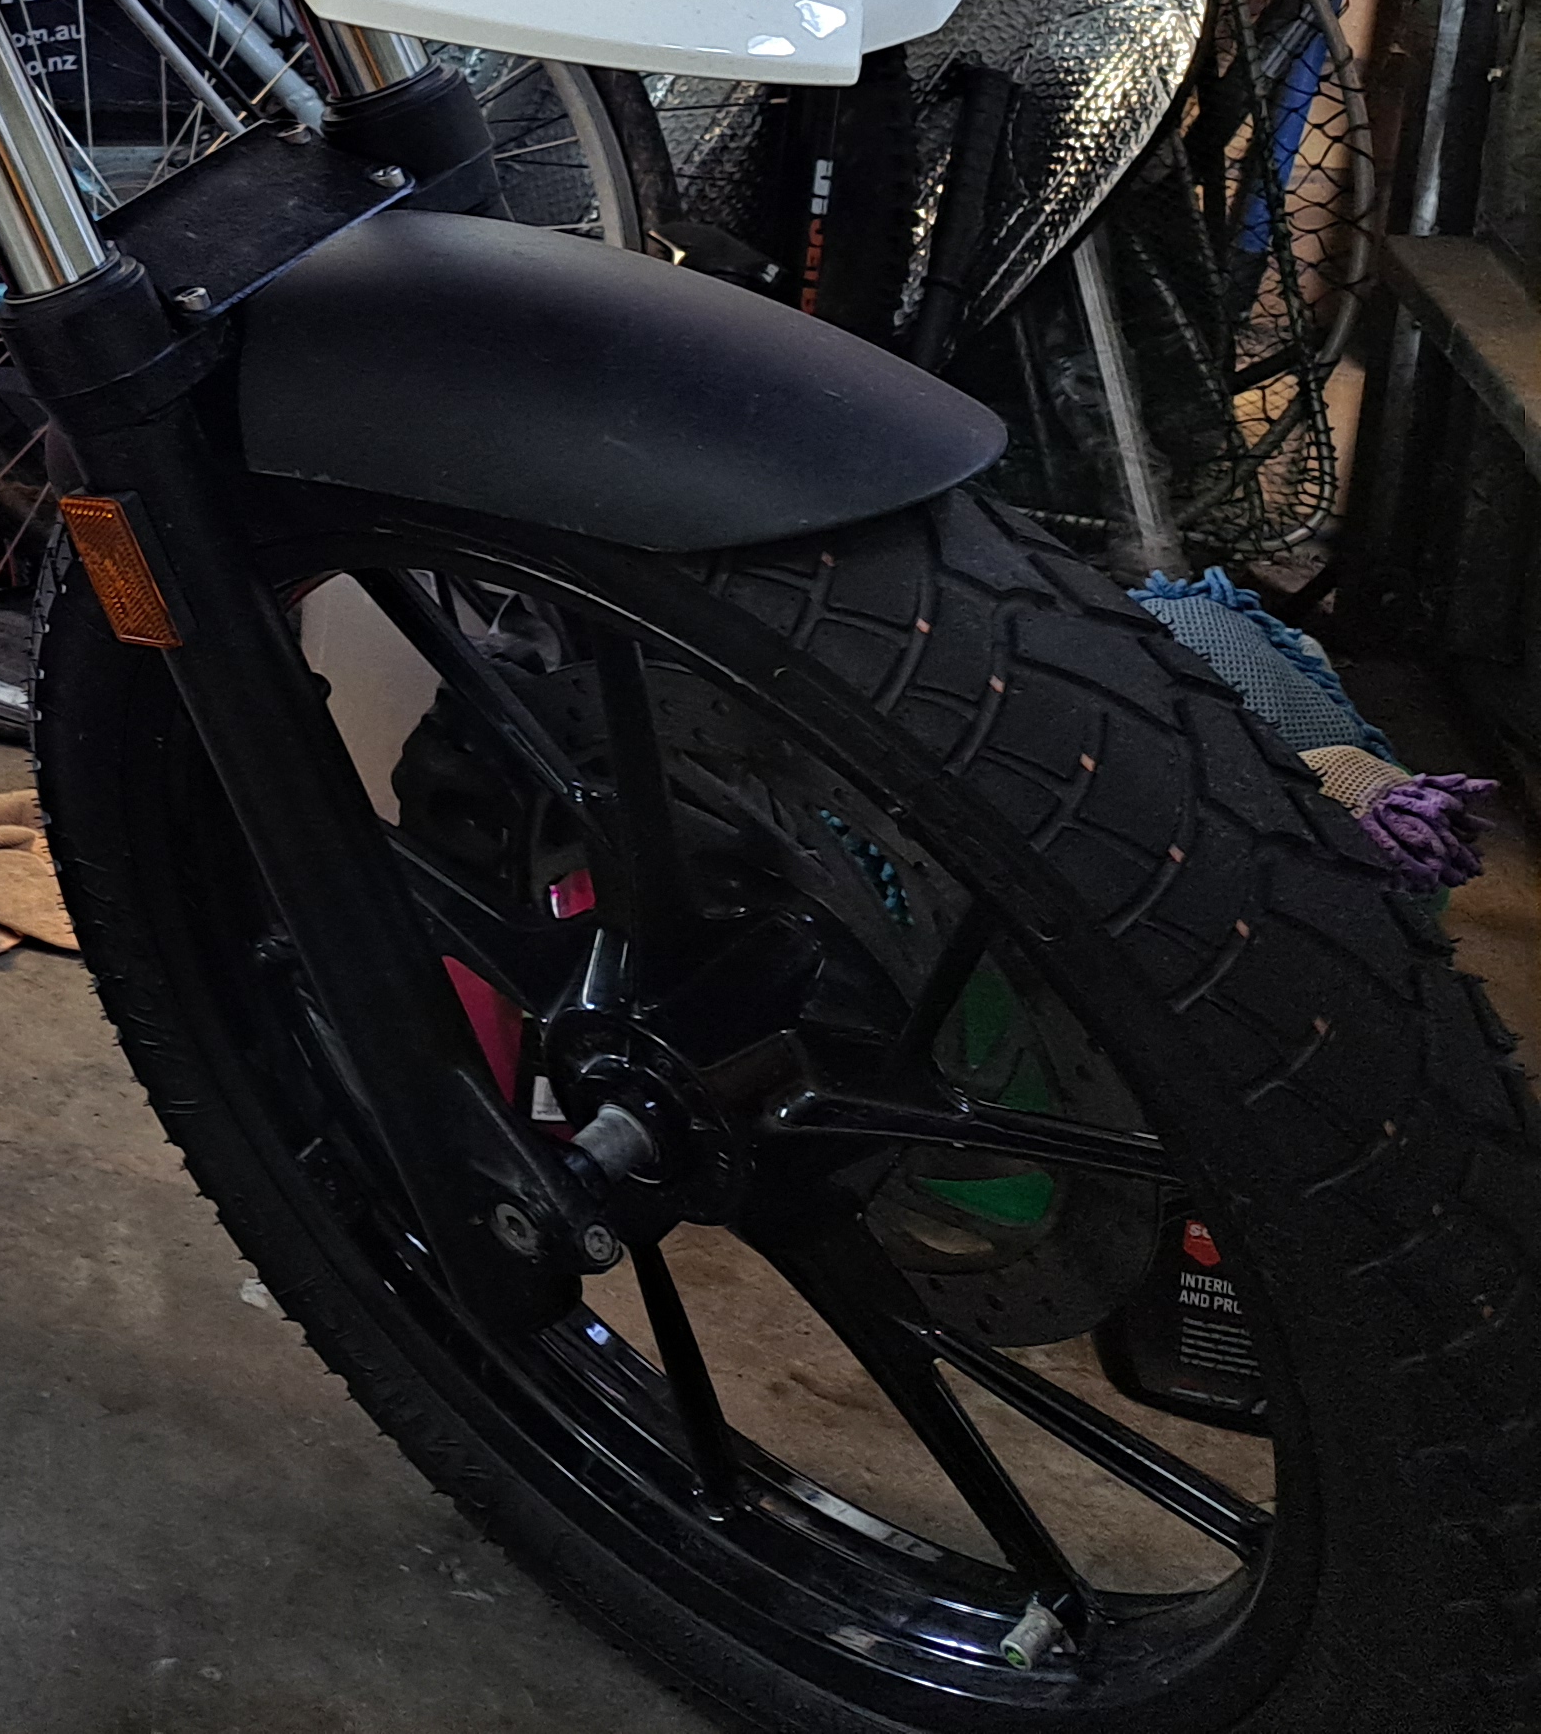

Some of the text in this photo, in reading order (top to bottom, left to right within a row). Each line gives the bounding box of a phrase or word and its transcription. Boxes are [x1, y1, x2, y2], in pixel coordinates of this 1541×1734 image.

[11, 23, 82, 48] om.au
[25, 54, 78, 76] o.nz
[1178, 1289, 1210, 1308] AND
